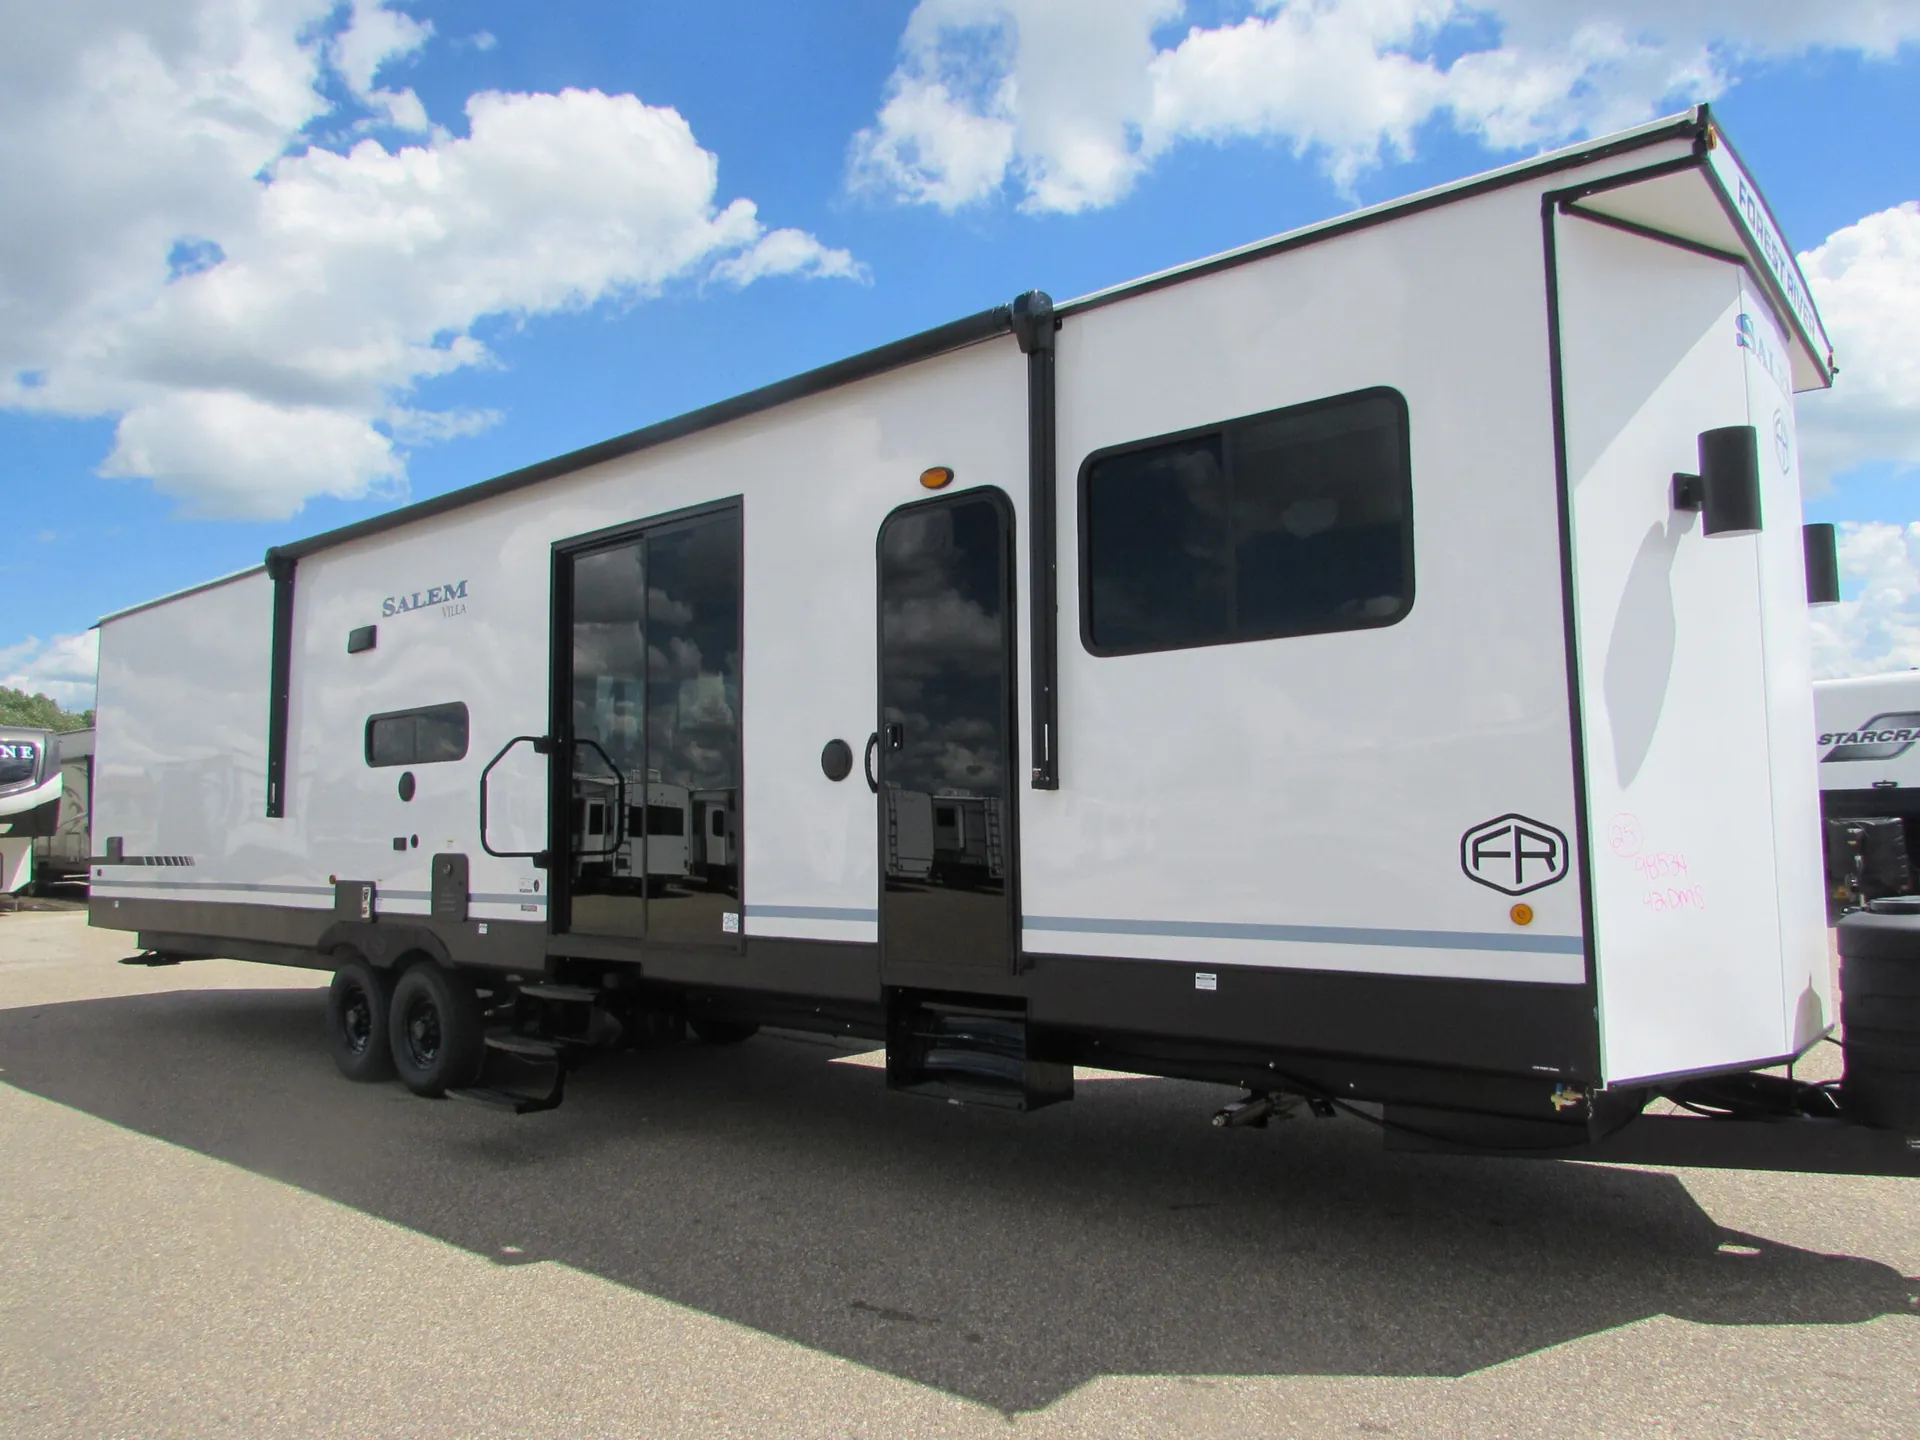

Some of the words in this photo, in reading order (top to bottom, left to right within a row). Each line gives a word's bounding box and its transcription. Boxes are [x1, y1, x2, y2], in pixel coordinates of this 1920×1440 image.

[1738, 177, 1787, 283] FOREST
[1786, 270, 1817, 342] RIVER
[382, 580, 468, 618] SALEM
[441, 603, 467, 618] VILLA
[1612, 823, 1637, 849] 25
